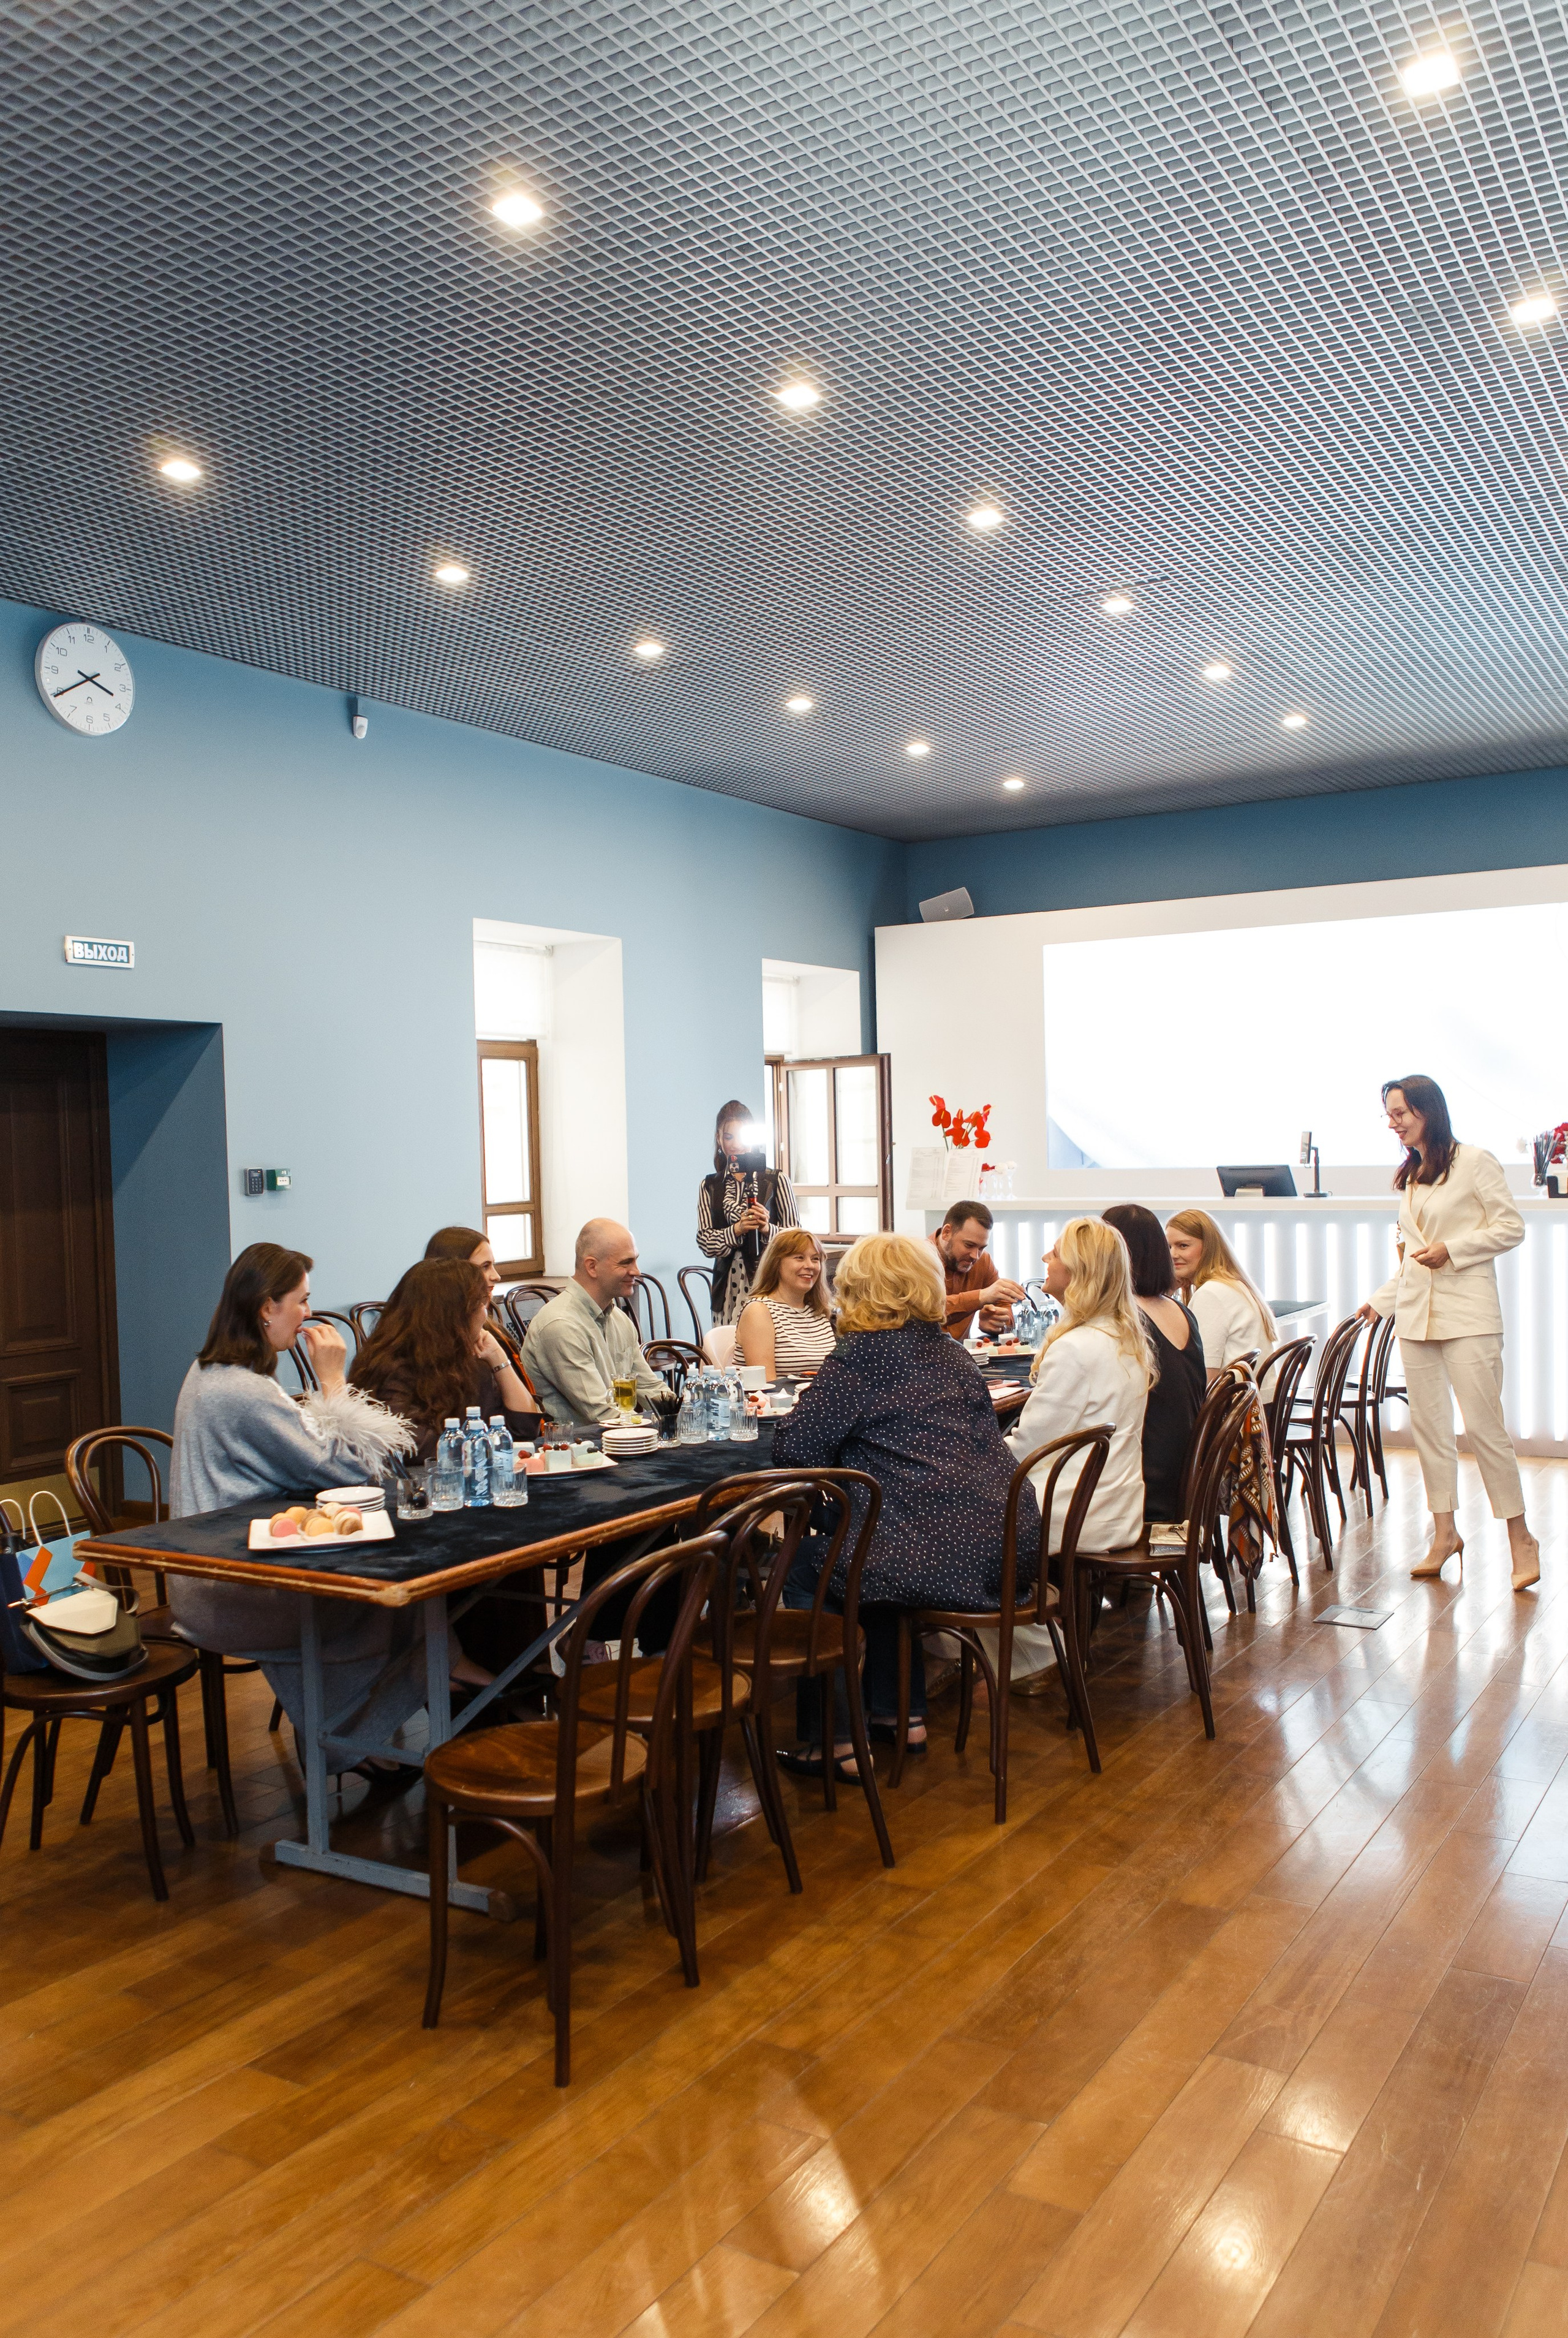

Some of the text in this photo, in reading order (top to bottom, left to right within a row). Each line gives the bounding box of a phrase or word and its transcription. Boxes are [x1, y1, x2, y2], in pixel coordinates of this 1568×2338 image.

[69, 635, 75, 644] 11
[84, 634, 94, 643] 12
[56, 647, 67, 656] 10
[51, 665, 59, 674] 9
[115, 663, 121, 672] 2
[119, 684, 126, 692] 3
[86, 715, 93, 724] 6
[104, 713, 110, 722] 5
[74, 942, 127, 963] ВЫХОД
